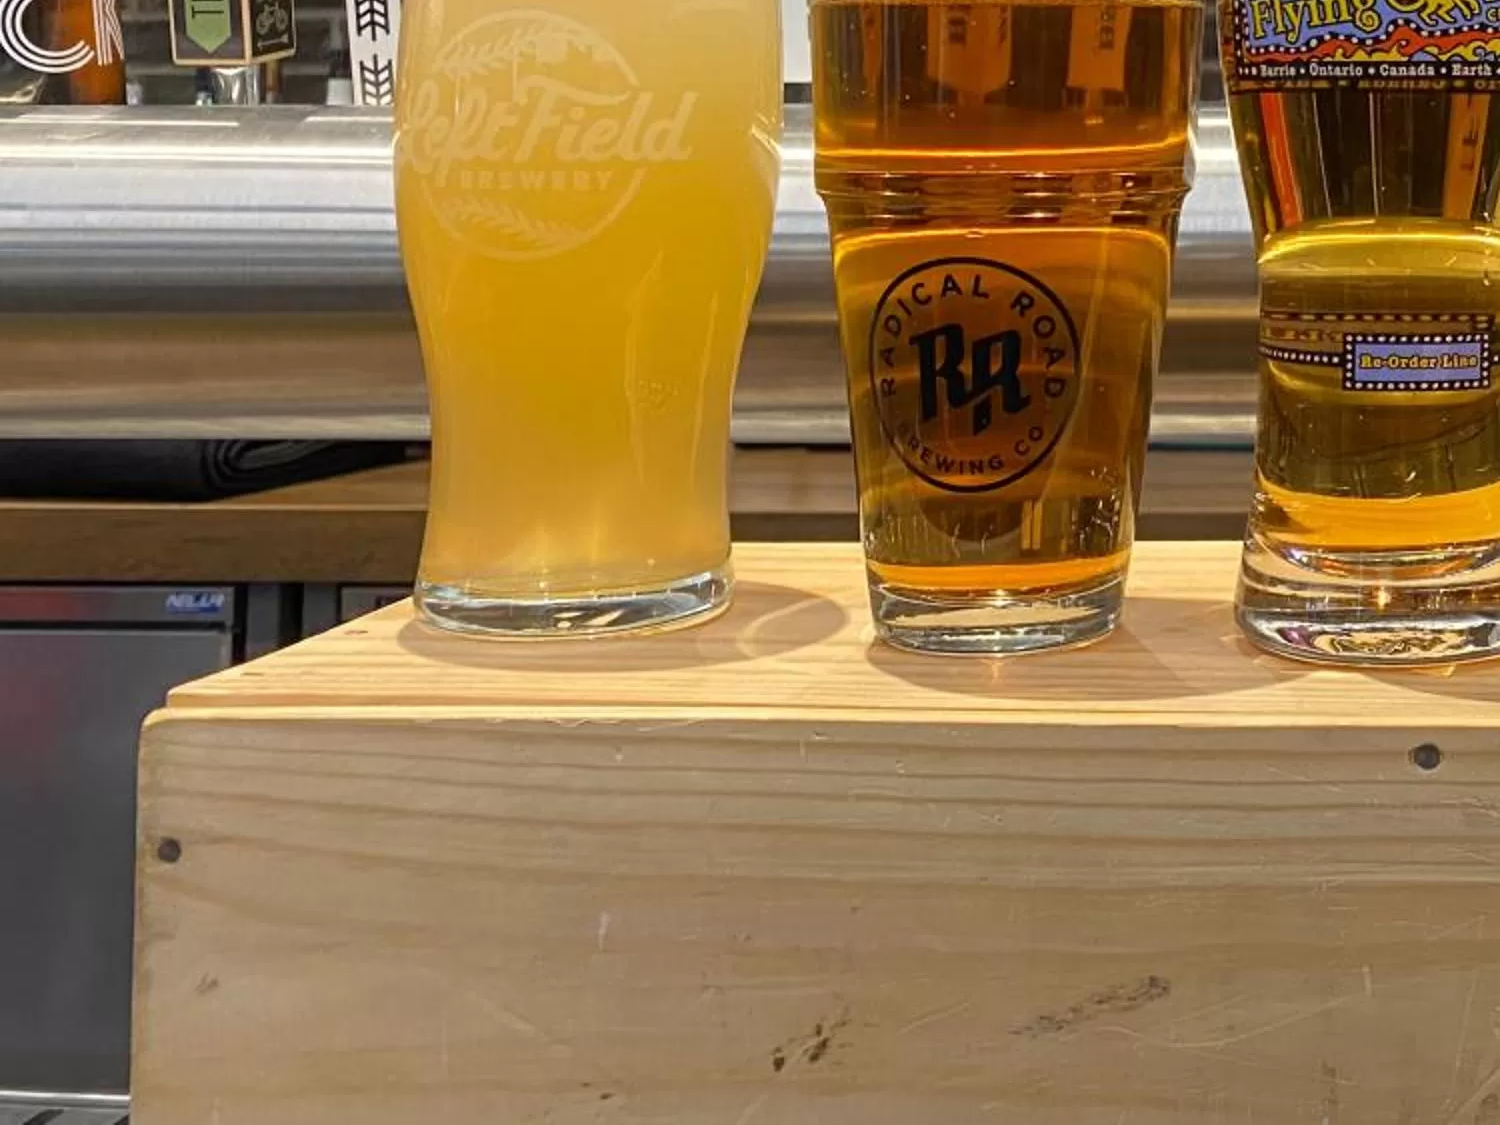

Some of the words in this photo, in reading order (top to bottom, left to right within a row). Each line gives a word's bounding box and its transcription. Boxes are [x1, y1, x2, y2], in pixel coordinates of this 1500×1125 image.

[1308, 62, 1363, 77] Ontario
[1379, 63, 1436, 77] Canada
[1451, 63, 1493, 77] Earth
[512, 75, 700, 164] Field
[880, 273, 990, 398] RADICAL
[1010, 290, 1067, 399] ROAD
[897, 423, 1006, 475] REWING
